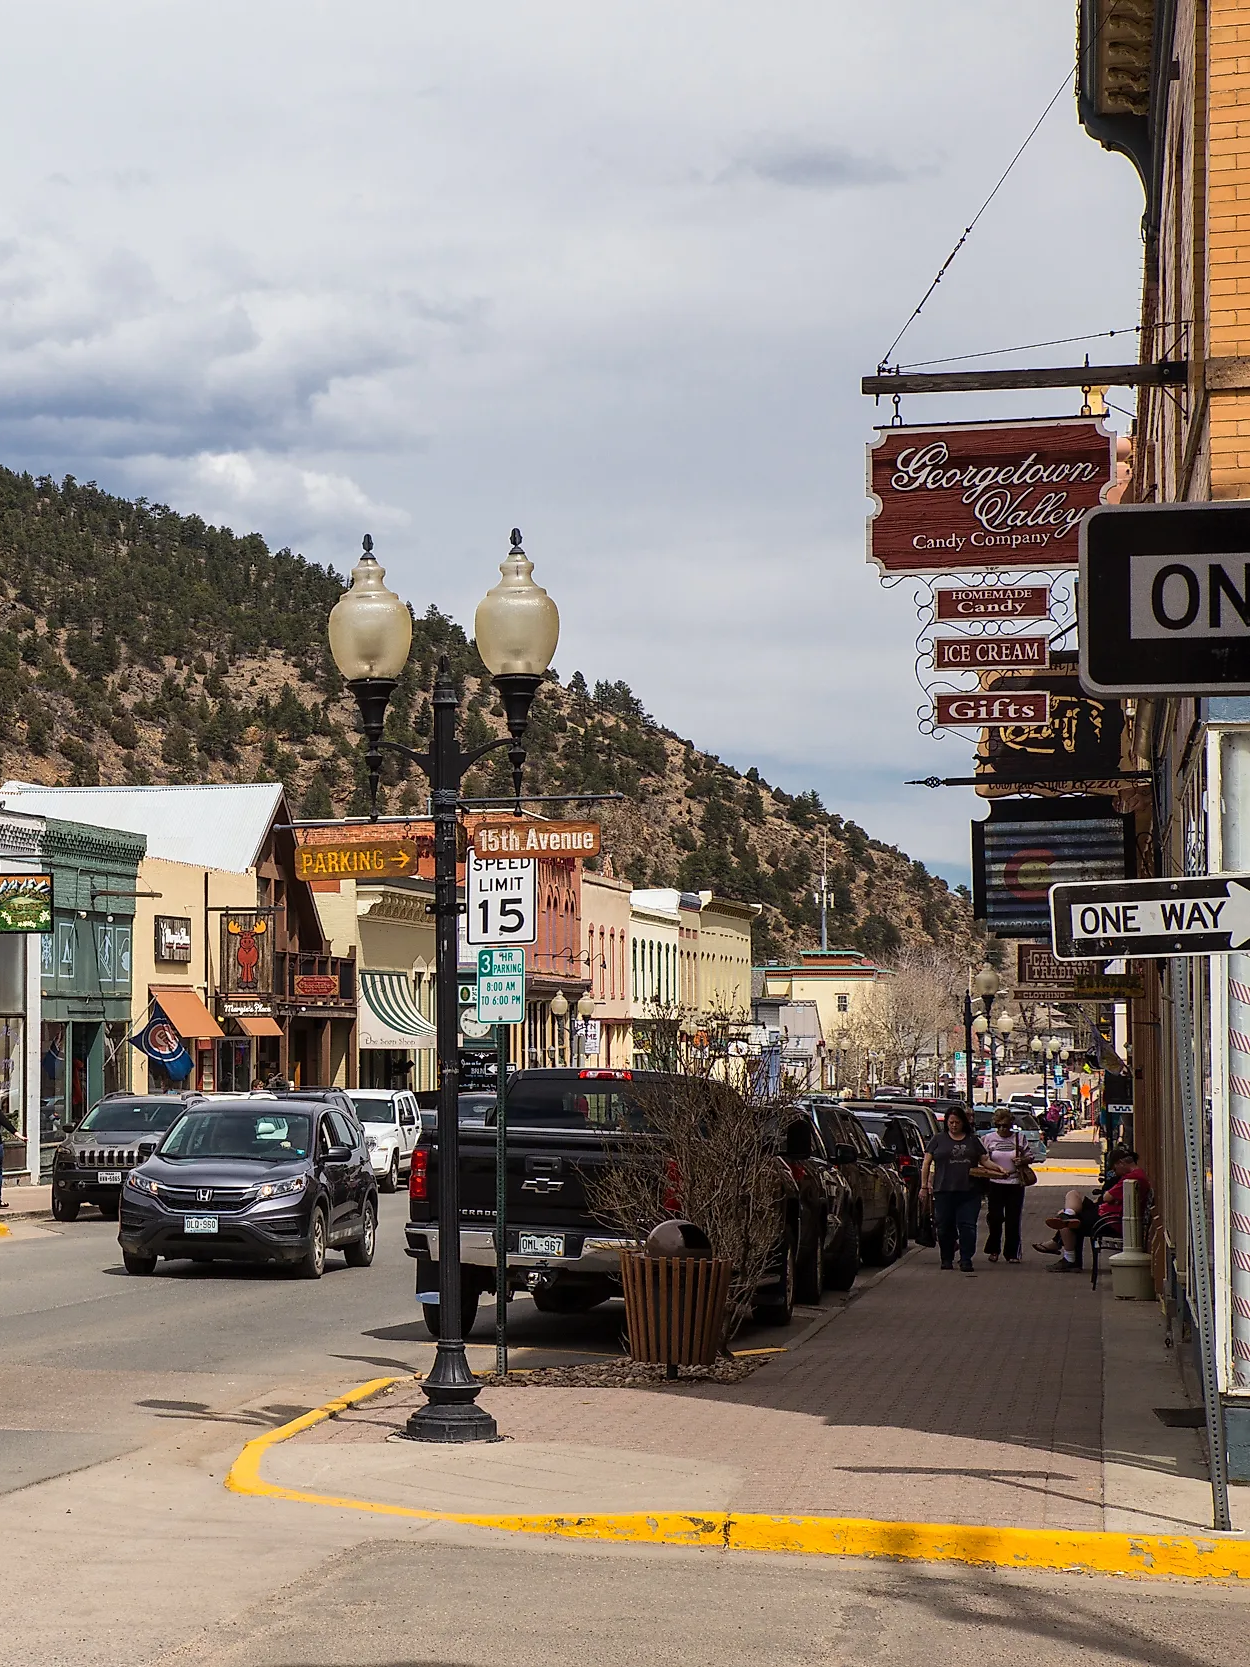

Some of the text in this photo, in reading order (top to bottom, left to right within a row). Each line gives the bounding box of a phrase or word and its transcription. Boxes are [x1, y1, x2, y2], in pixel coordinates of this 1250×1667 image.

[891, 441, 1099, 503] Georgetown
[974, 486, 1088, 538] Valley
[912, 531, 1051, 551] Candy Company
[951, 589, 1033, 600] HOMEMADE
[957, 599, 1026, 614] Candy
[942, 642, 1039, 662] ICE CREAM
[948, 698, 1035, 719] Gifts
[526, 828, 594, 851] Avenue
[301, 849, 385, 874] PARKING
[473, 858, 530, 872] SPEED
[479, 877, 523, 892] LIMIT
[478, 898, 525, 934] 15
[1079, 901, 1226, 935] ONE WAY
[480, 954, 491, 974] 3
[500, 952, 514, 962] HR
[493, 962, 522, 974] PARKING
[486, 981, 516, 992] 8:00 AM
[1022, 991, 1066, 999] CLOTHING
[481, 994, 521, 1006] TO 6:00 PM
